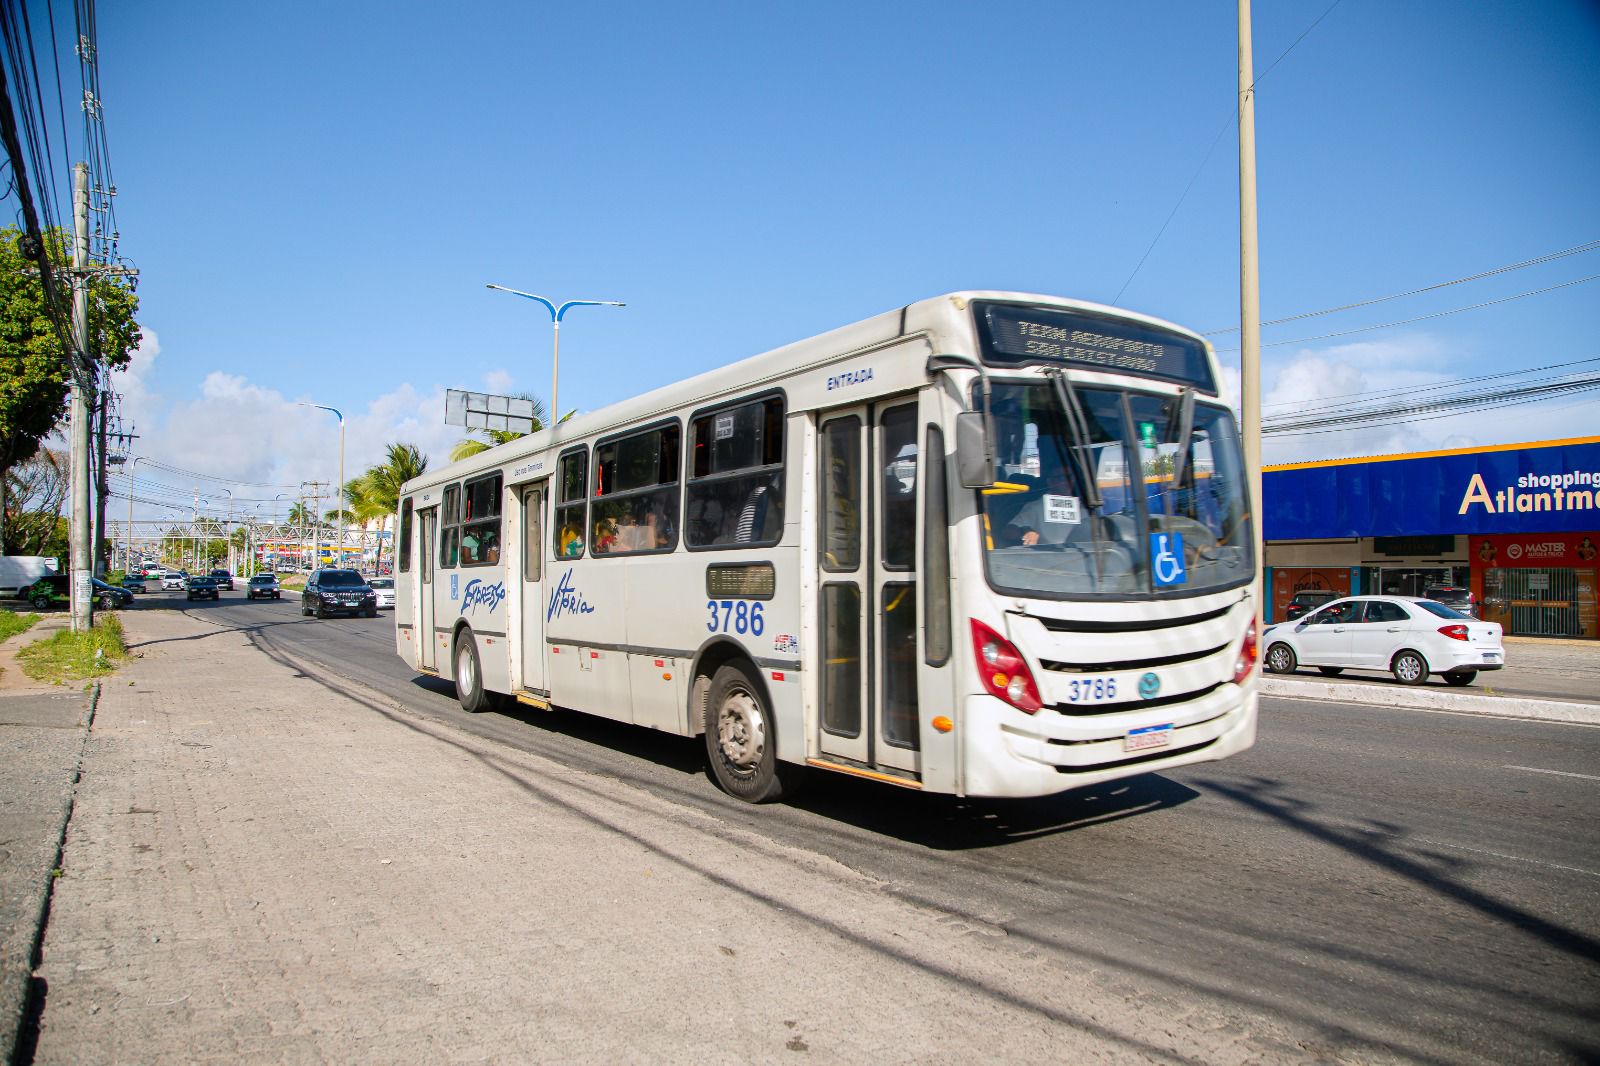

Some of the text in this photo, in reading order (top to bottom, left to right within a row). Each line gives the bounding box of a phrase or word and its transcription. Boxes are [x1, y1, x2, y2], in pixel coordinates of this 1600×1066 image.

[1070, 330, 1164, 357] AEROPORTO
[827, 367, 874, 391] ENTRADA
[1517, 470, 1600, 490] shopping
[1525, 542, 1567, 553] MASTER
[706, 600, 764, 637] 3786
[1068, 677, 1117, 702] 3786
